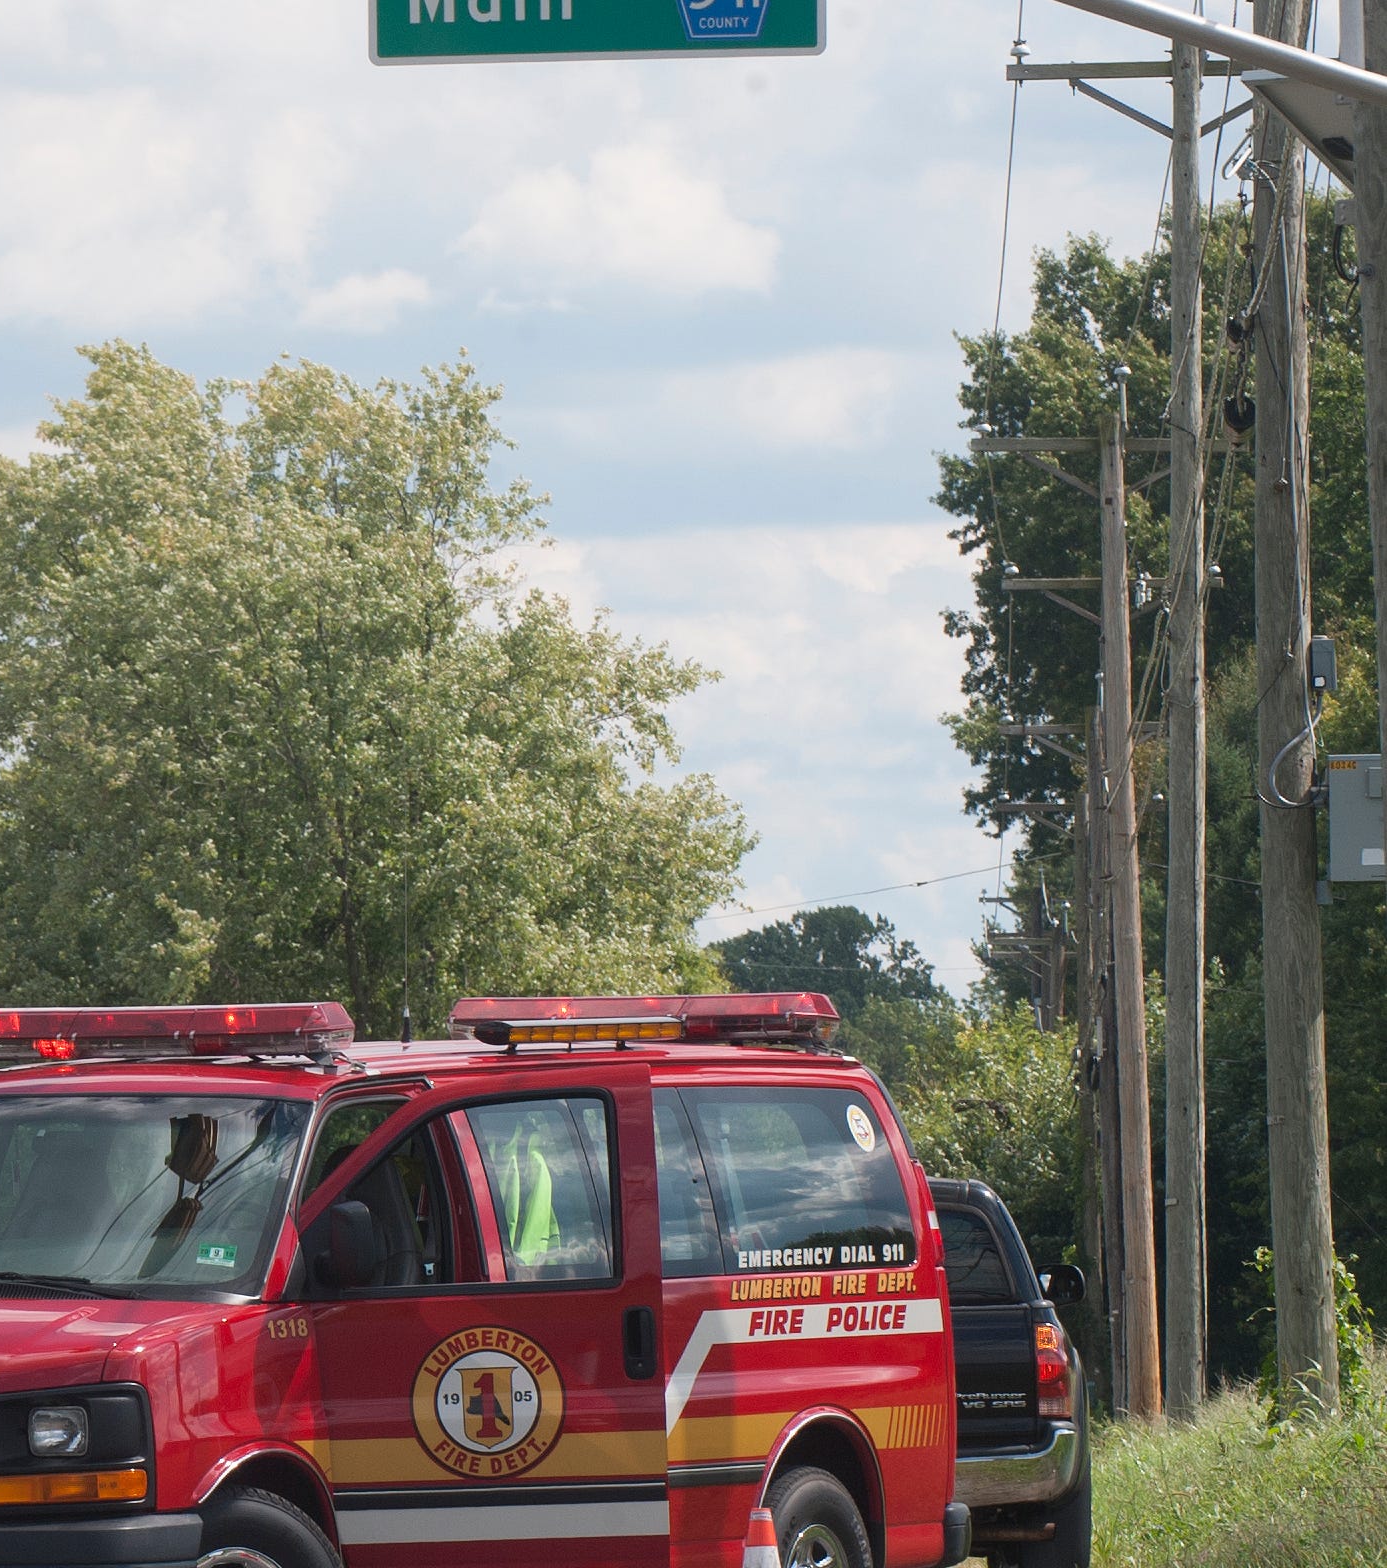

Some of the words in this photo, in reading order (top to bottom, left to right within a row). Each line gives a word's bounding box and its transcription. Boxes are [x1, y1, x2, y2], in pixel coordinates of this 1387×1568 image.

[699, 17, 749, 29] COUNTY
[738, 1247, 833, 1269] EMERGENCY
[841, 1246, 875, 1263] DIAL
[883, 1244, 904, 1261] 911
[731, 1275, 821, 1301] LUMBERTON
[832, 1274, 866, 1296] FIRE
[877, 1272, 916, 1294] DEPT.
[267, 1319, 309, 1339] 1318
[749, 1308, 804, 1337] FIRE
[826, 1304, 907, 1333] POLICE
[424, 1329, 551, 1377] LUMBERTON
[442, 1392, 460, 1406] 19
[514, 1390, 533, 1403] 05
[474, 1372, 503, 1438] 1
[963, 1401, 986, 1409] V6
[434, 1439, 480, 1474] FIRE
[489, 1437, 548, 1475] DEPT.
